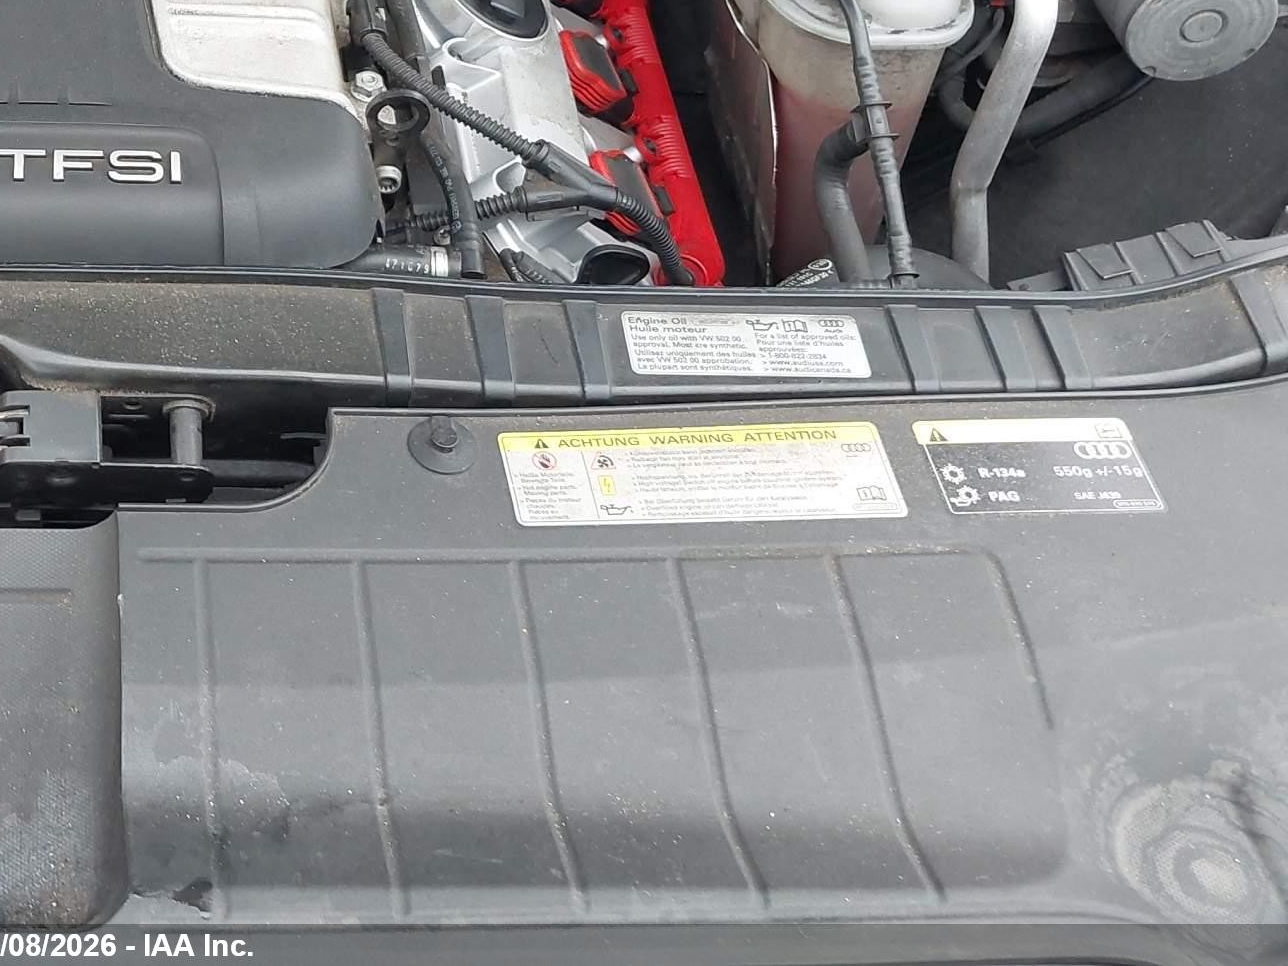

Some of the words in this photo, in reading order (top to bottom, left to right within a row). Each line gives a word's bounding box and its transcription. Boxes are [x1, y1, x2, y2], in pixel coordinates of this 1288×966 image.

[627, 316, 667, 326] Engine
[671, 317, 687, 325] Oil
[629, 325, 659, 333] Huile
[558, 436, 640, 447] ACHTUNG
[649, 433, 734, 444] WARNING
[744, 430, 837, 442] ATTENTION
[977, 467, 1026, 478] R-134a
[1053, 465, 1093, 478] 550g
[988, 490, 1021, 502] PAG
[1073, 491, 1097, 500] SAE
